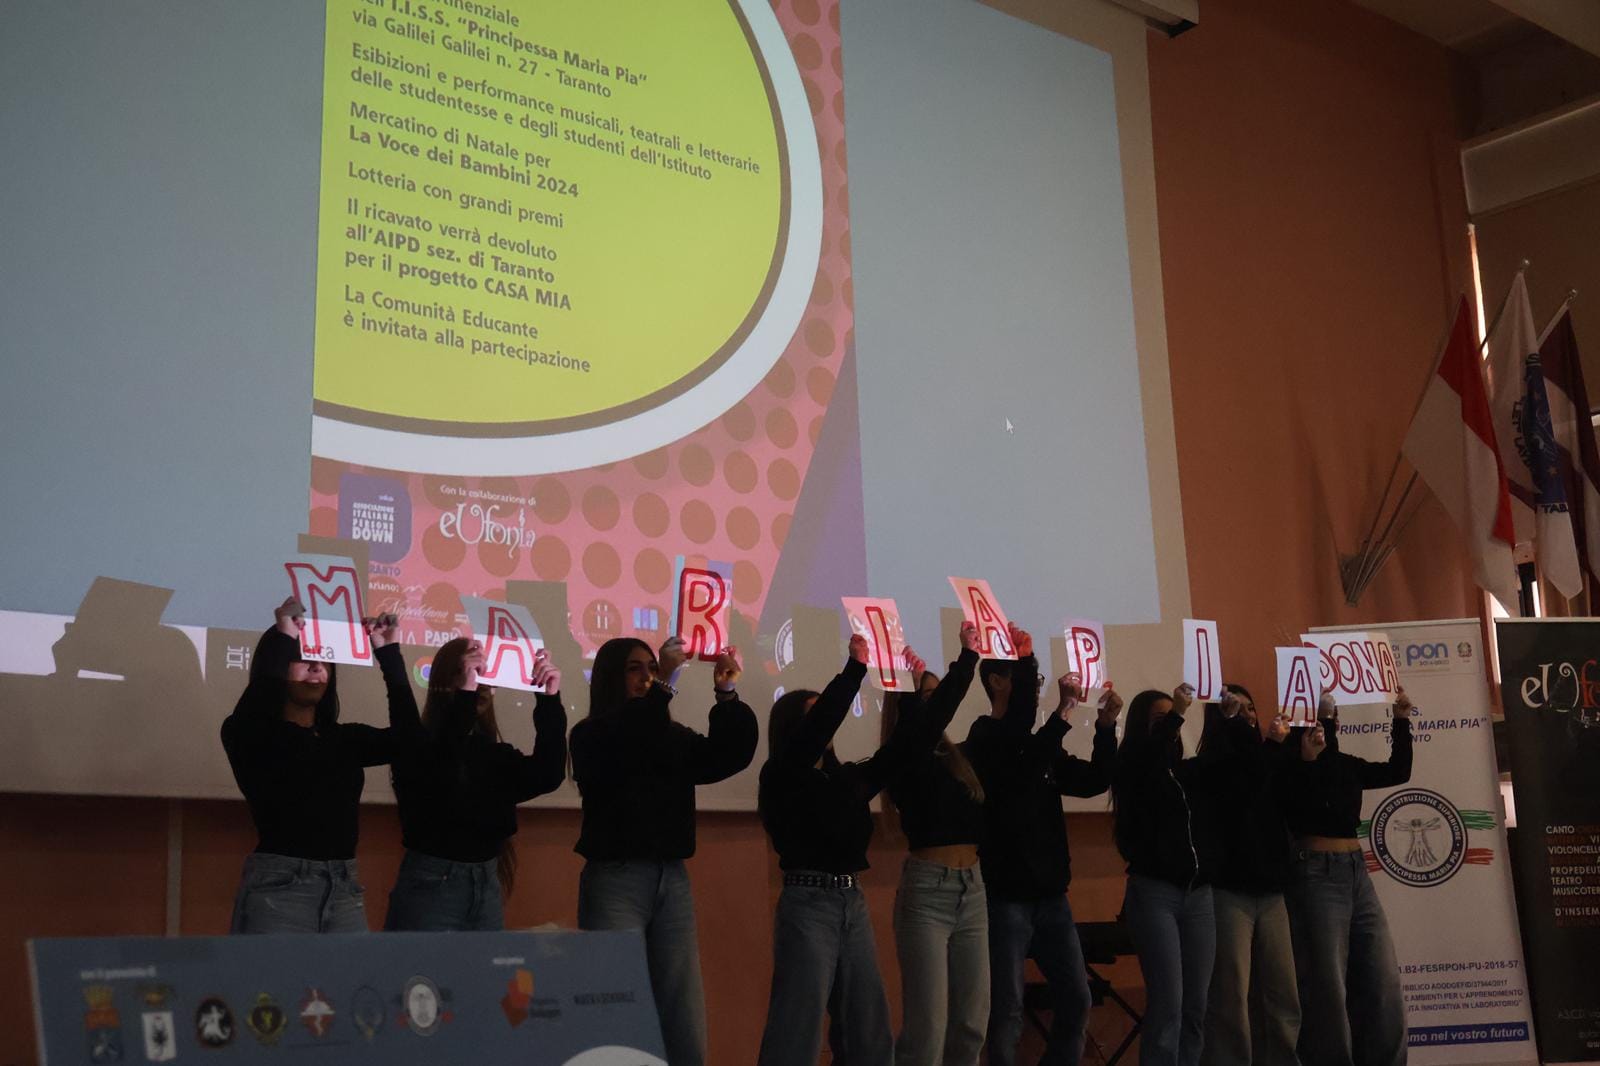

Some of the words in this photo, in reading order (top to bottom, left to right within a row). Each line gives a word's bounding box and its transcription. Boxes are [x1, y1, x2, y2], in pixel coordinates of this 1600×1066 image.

[353, 9, 377, 28] via
[384, 17, 435, 45] Galilei
[442, 35, 490, 62] Galilei
[496, 54, 512, 68] n.
[518, 57, 538, 76] 27
[556, 69, 612, 98] Taranto
[458, 17, 558, 61] “Principessa
[563, 50, 609, 77] Maria
[350, 101, 438, 139] Mercatino
[444, 127, 460, 145] di
[466, 132, 520, 161] Natale
[525, 151, 551, 169] per
[351, 66, 393, 91] delle
[400, 82, 498, 120] studentesse
[504, 112, 514, 125] e
[520, 114, 558, 138] degli
[564, 127, 625, 157] studenti
[352, 42, 431, 79] Esibizioni
[437, 72, 448, 84] e
[453, 75, 554, 114] performance
[560, 105, 624, 136] musicali,
[630, 125, 681, 152] teatrali
[686, 142, 694, 154] e
[699, 143, 760, 174] letterarie
[350, 124, 371, 145] La
[378, 132, 420, 157] Voce
[426, 146, 454, 166] dei
[460, 153, 531, 186] Bambini
[536, 174, 579, 198] 2024
[348, 161, 416, 193] Lotteria
[423, 183, 453, 201] con
[459, 192, 512, 216] grandi
[518, 207, 563, 229] premi
[346, 224, 420, 253] all’AIPD
[427, 244, 462, 263] sez.
[469, 251, 485, 269] di
[491, 255, 555, 283] Taranto
[347, 198, 358, 215] Il
[365, 203, 432, 233] ricavato
[439, 223, 481, 244] verrà
[488, 232, 557, 261] devoluto
[345, 250, 375, 268] per
[382, 254, 393, 272] il
[399, 262, 478, 290] progetto
[484, 277, 529, 301] CASA
[535, 288, 571, 311] MIA
[345, 285, 365, 305] La
[372, 291, 456, 322] Comunità
[463, 309, 539, 339] Educante
[343, 310, 354, 328] è
[362, 312, 428, 341] invitata
[435, 328, 465, 349] alla
[471, 338, 591, 373] partecipazione
[352, 510, 394, 521] ITALIANA
[352, 518, 394, 531] PERSONE
[440, 484, 456, 496] Con
[459, 487, 466, 496] la
[468, 490, 526, 504] collaborazione
[528, 497, 536, 506] di
[352, 527, 393, 543] DOWN
[284, 562, 371, 660] M
[676, 568, 725, 662] R
[968, 586, 1017, 656] A
[478, 606, 543, 686] A
[865, 606, 896, 687] I
[1071, 626, 1101, 702] P
[1196, 628, 1211, 700] I
[1406, 643, 1448, 666] pon
[1282, 656, 1316, 722] A
[1418, 719, 1457, 730] MARIA
[1545, 825, 1575, 834] CANTO
[1382, 854, 1428, 880] PRINCIPESSA
[1429, 864, 1453, 879] MARIA
[1551, 876, 1583, 885] TEATRO
[1408, 1033, 1427, 1043] mo
[1431, 1030, 1448, 1041] nel
[1451, 1028, 1487, 1041] vostro
[1490, 1027, 1525, 1039] futuro
